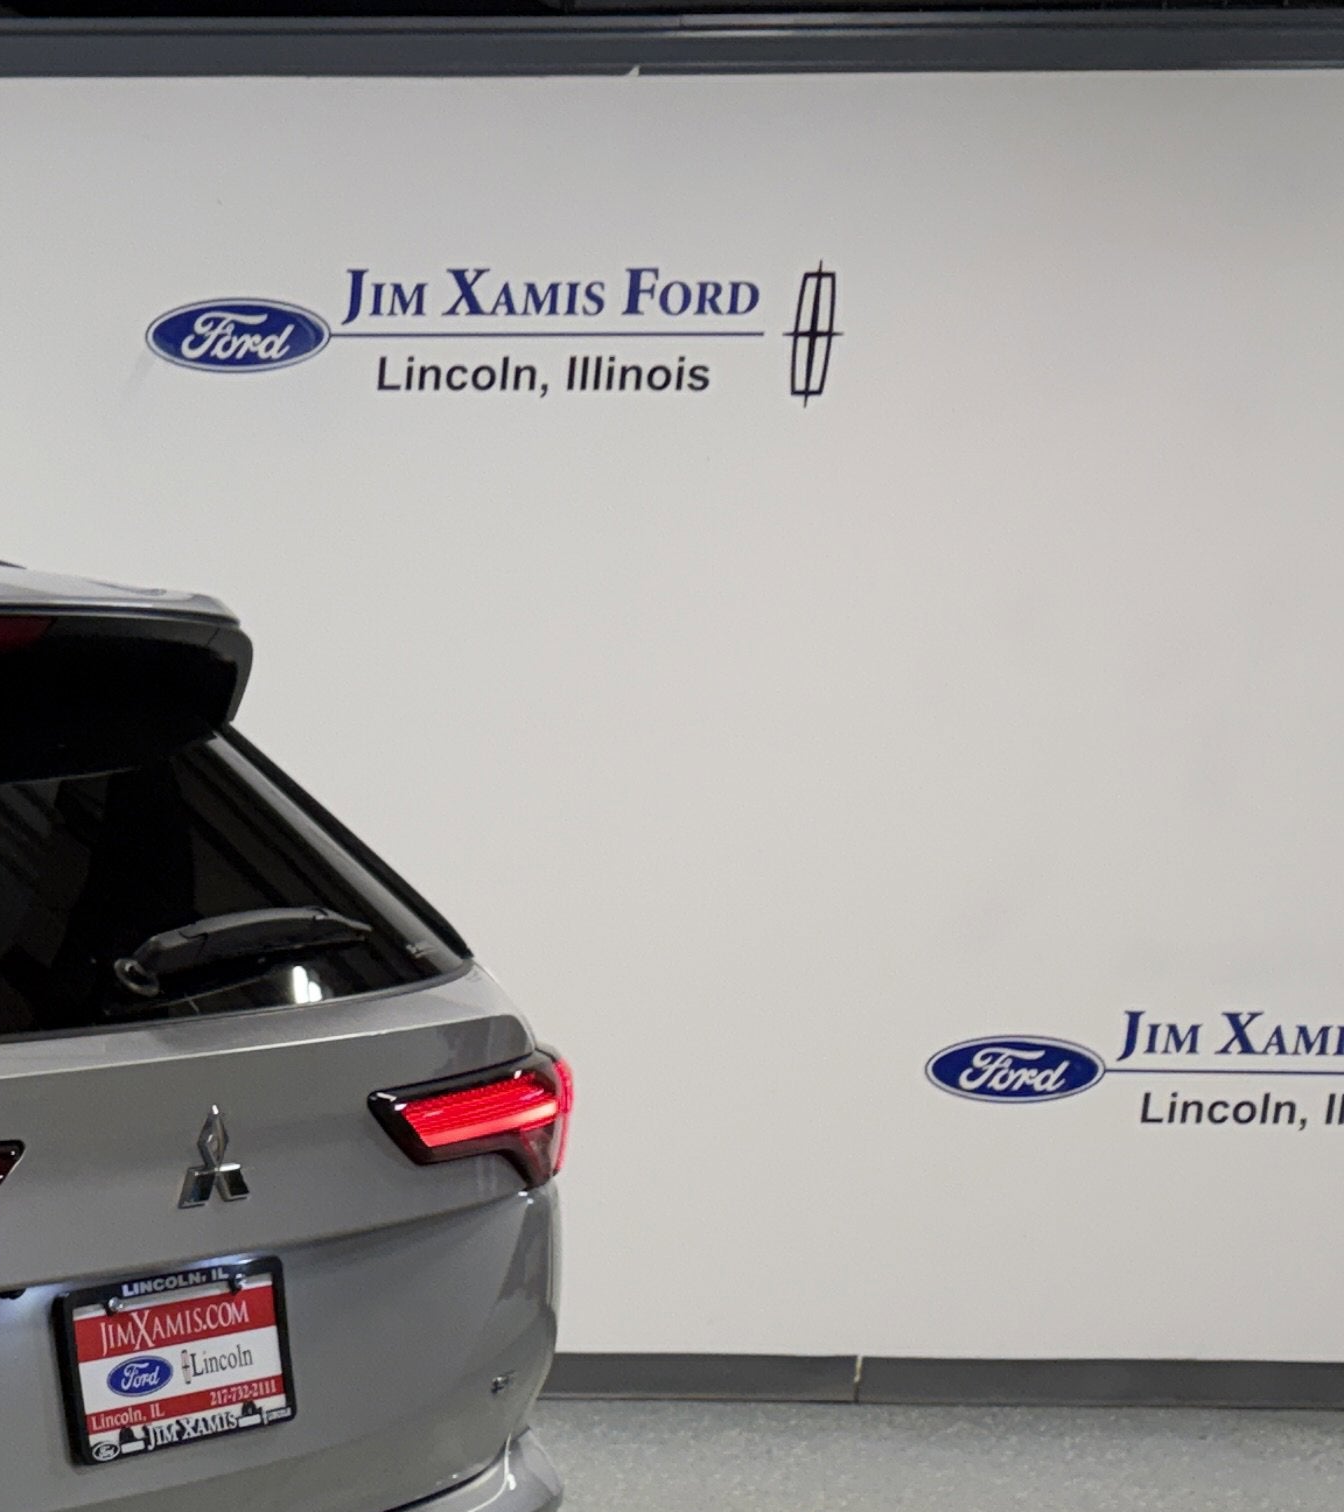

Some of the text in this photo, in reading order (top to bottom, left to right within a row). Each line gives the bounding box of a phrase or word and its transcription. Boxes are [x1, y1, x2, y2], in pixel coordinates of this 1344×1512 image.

[341, 267, 760, 325] JIM XAMIS FORD
[181, 310, 291, 361] Ford
[376, 355, 710, 398] Lincoln, Illinois
[1117, 1010, 1203, 1062] JIM
[958, 1047, 1070, 1092] Ford
[1141, 1091, 1309, 1131] Lincoln,
[121, 1267, 229, 1297] LINCOLN, IL
[121, 1361, 161, 1391] Ford
[191, 1345, 254, 1377] Lincoln
[91, 1403, 166, 1430] Lincoln, IL
[147, 1423, 179, 1450] JIM
